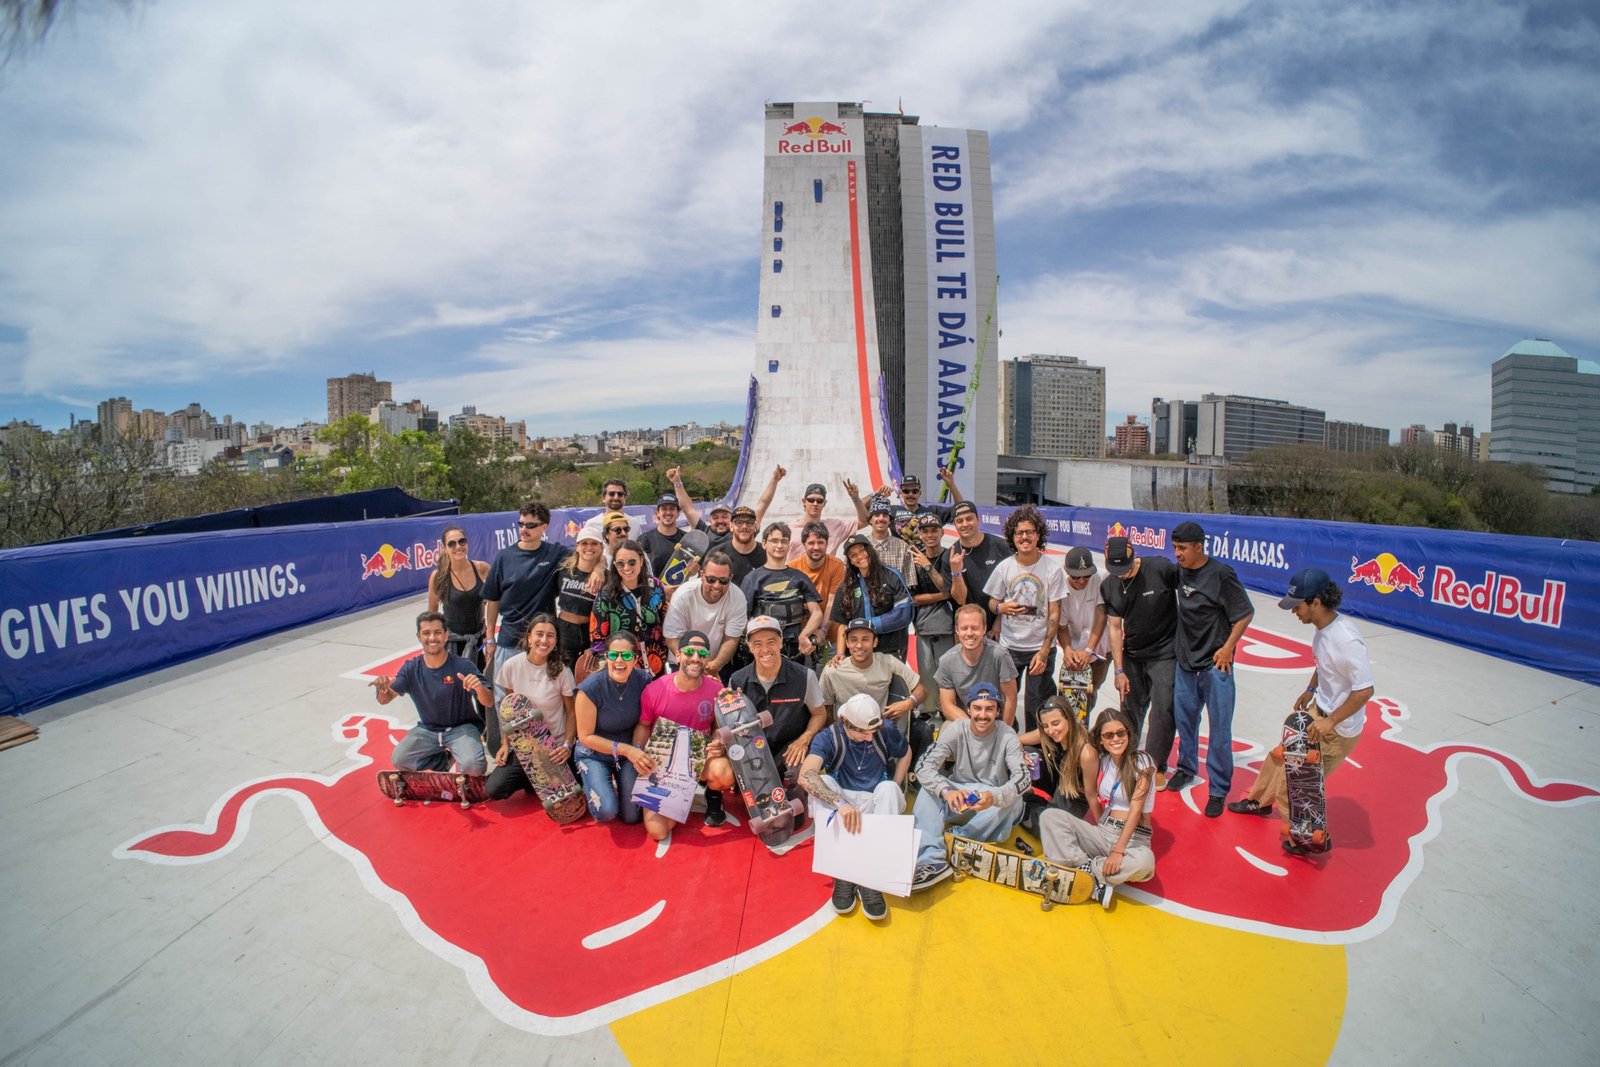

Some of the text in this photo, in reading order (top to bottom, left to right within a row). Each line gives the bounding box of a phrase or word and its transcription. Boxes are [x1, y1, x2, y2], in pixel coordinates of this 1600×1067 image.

[778, 139, 852, 154] Red Bull
[931, 145, 962, 192] RED
[934, 202, 965, 263] BULL
[936, 272, 967, 300] TE
[938, 312, 975, 350] DÁ
[495, 529, 506, 551] TE
[1130, 526, 1167, 550] Red Bull
[1203, 530, 1290, 571] E DÁ AAASAS.
[1, 562, 306, 660] GIVES YOU WIIINGS.
[1431, 565, 1567, 629] Red Bull
